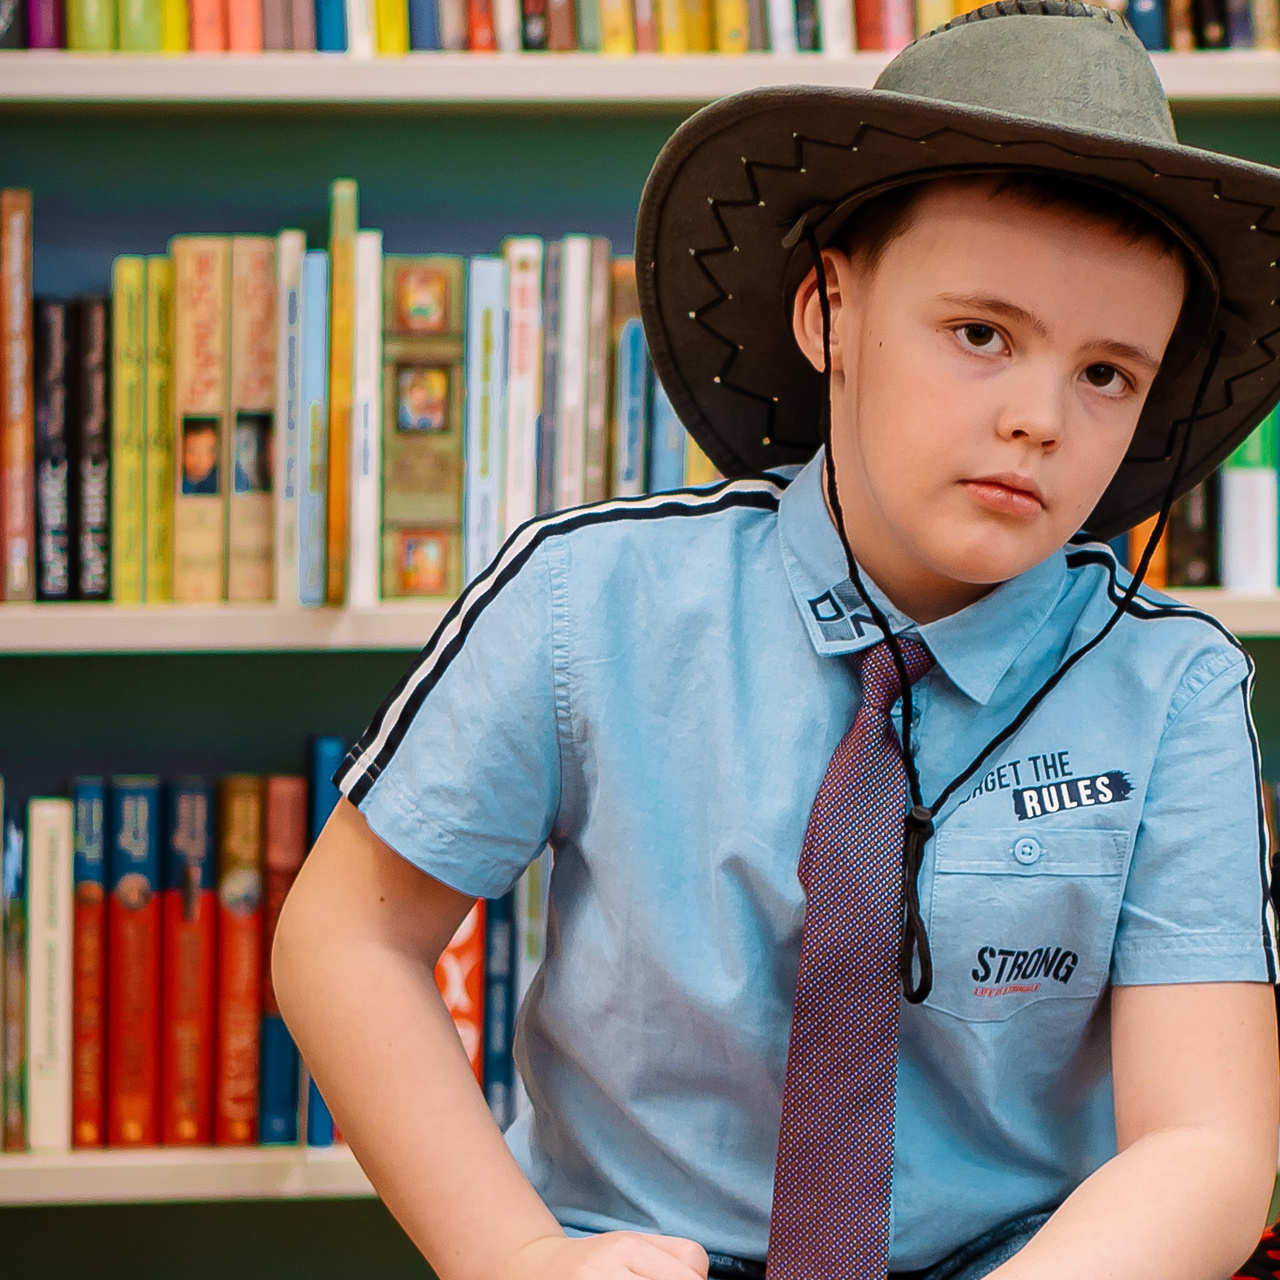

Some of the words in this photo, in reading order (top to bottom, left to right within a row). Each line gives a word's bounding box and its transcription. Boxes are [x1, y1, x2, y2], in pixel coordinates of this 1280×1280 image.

[1028, 751, 1073, 782] THE
[1023, 776, 1113, 818] RULES
[971, 945, 1079, 984] STRONG
